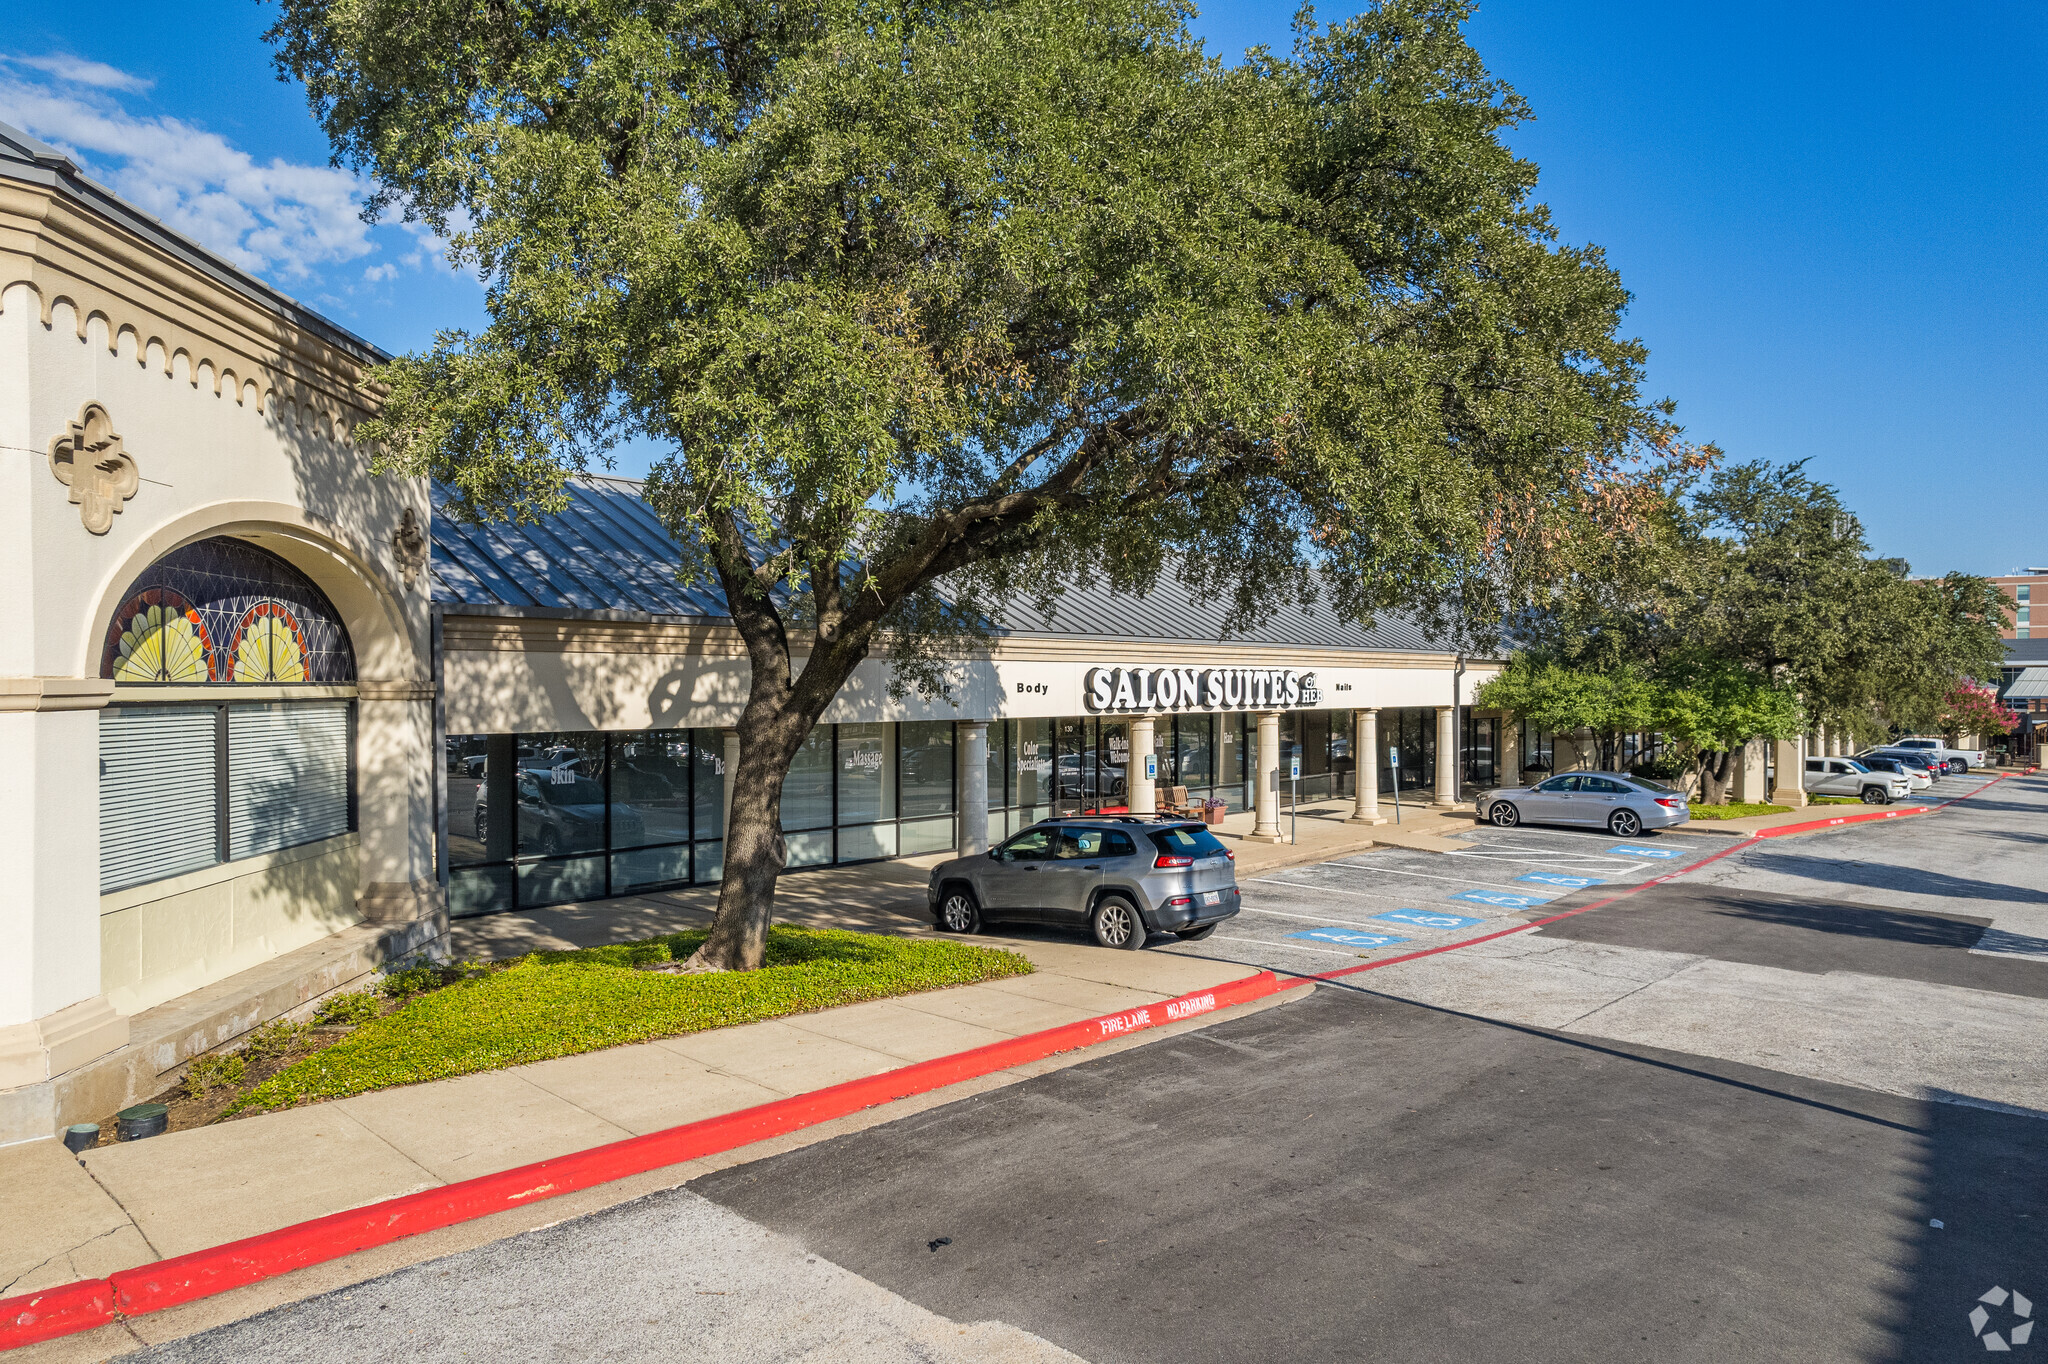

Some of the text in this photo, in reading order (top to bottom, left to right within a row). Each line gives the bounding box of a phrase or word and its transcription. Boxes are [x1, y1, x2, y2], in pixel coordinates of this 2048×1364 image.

[1016, 683, 1049, 696] Body
[1091, 669, 1299, 709] SALON SUITES
[1301, 689, 1324, 703] HEB
[1335, 682, 1352, 691] Nails
[1023, 741, 1039, 756] Color
[852, 750, 883, 770] Massage
[551, 765, 576, 786] Skin
[1166, 993, 1216, 1018] NO PARKING
[1100, 1009, 1151, 1035] FIRE LANE
